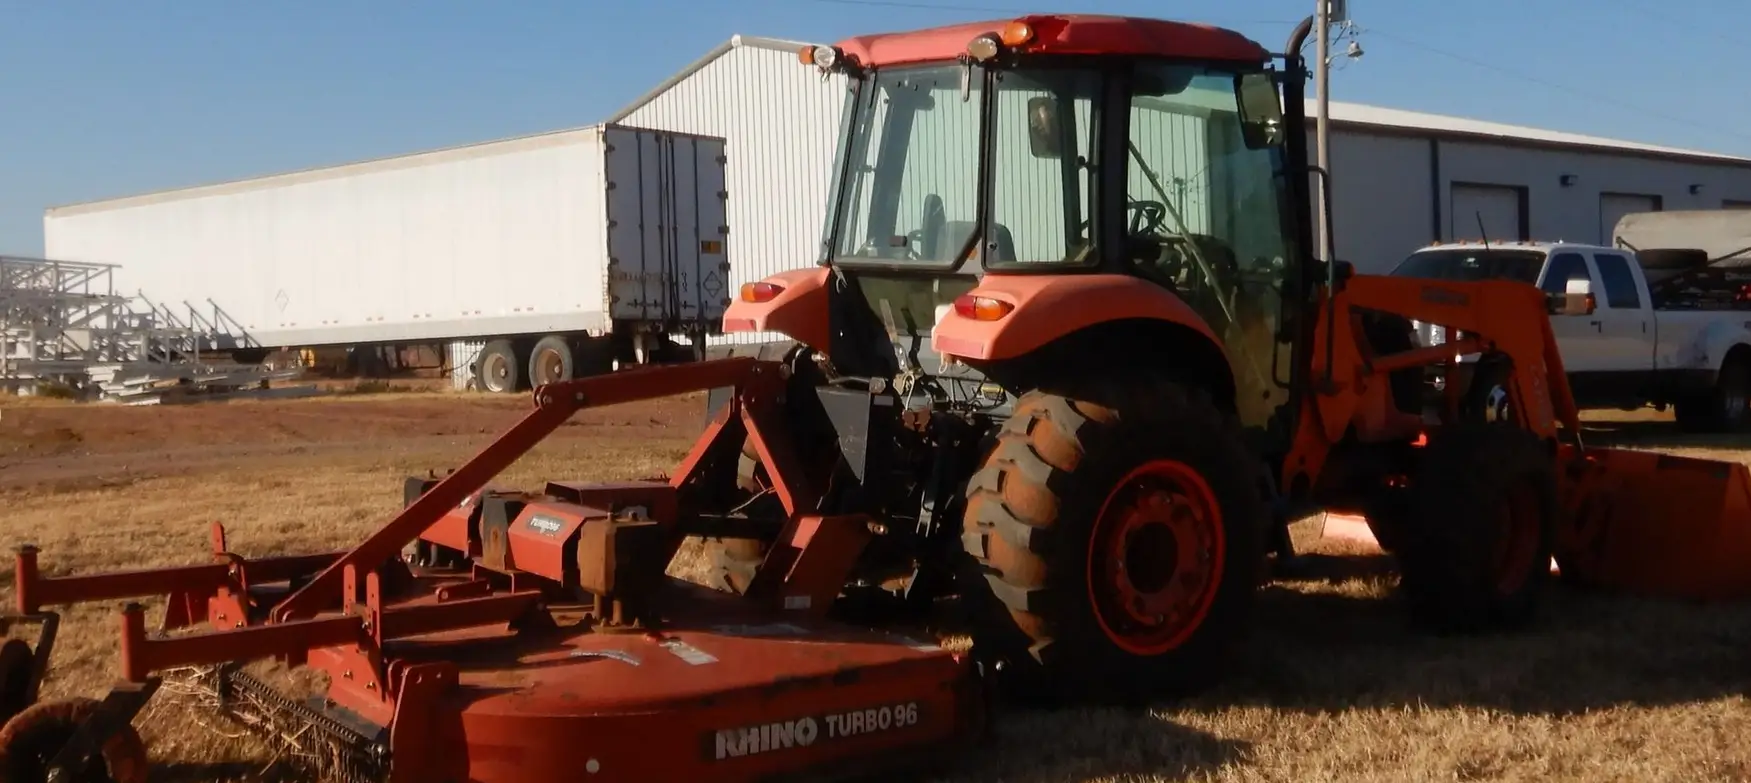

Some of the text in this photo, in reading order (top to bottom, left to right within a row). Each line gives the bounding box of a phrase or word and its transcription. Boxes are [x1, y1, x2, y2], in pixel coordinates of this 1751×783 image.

[715, 702, 918, 759] RHINO TURBO 96
